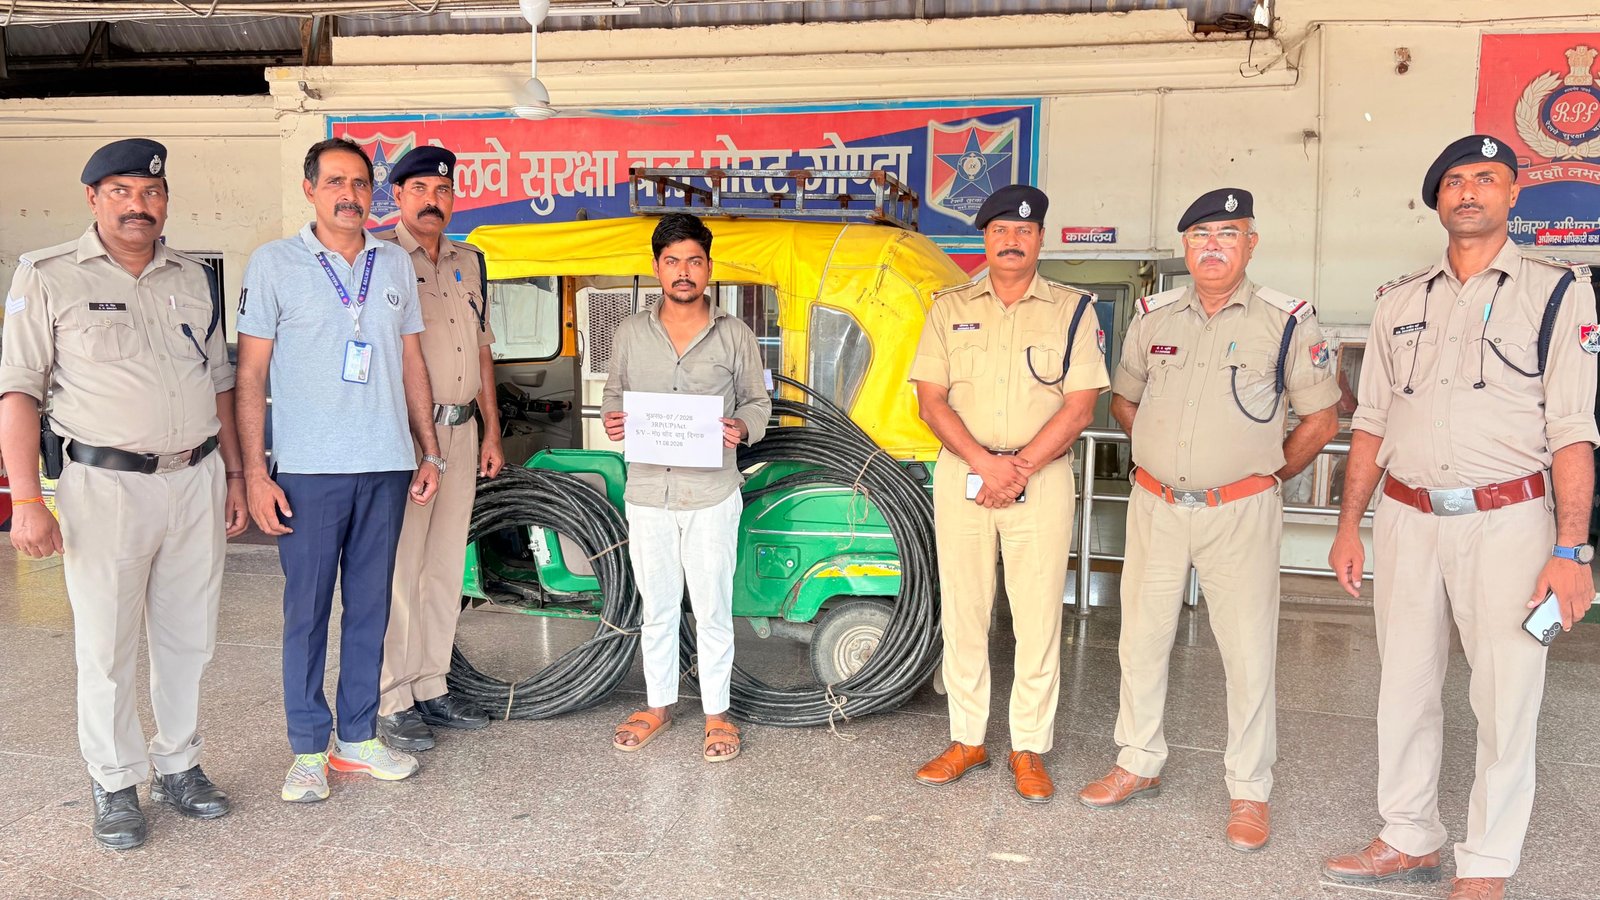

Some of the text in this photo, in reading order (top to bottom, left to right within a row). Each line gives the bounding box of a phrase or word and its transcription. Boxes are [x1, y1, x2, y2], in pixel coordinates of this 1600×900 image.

[428, 137, 511, 199] लवे
[519, 151, 619, 216] सुरक्षा
[701, 134, 793, 195] पोस्ट
[1507, 216, 1550, 234] धीनस्थ
[1065, 228, 1114, 242] कार्यालय
